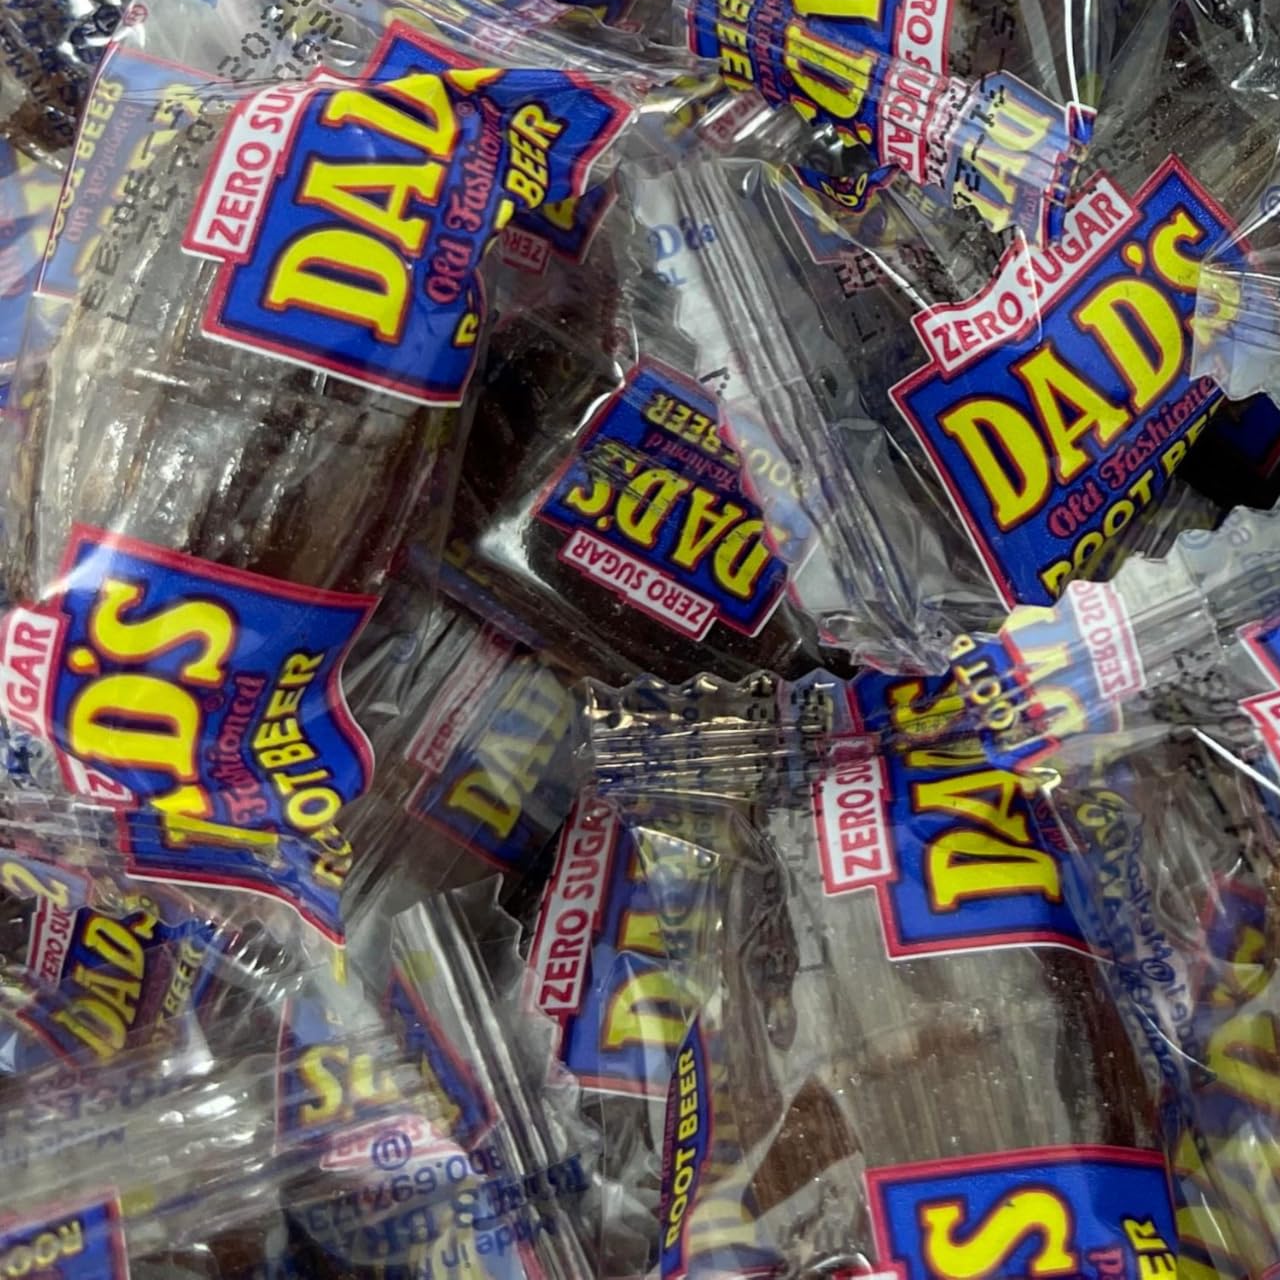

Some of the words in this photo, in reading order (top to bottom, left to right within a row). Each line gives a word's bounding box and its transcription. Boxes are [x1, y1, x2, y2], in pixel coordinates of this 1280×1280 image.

[506, 104, 564, 206] BEER
[880, 50, 938, 172] SUGAR
[209, 140, 267, 248] ZERO
[430, 240, 473, 304] Old
[932, 288, 1024, 362] ZERO
[1017, 196, 1126, 306] SUGAR
[942, 212, 1240, 531] DAD'S
[570, 465, 772, 600] DAD'S
[572, 537, 648, 586] SUGAR
[1048, 483, 1101, 538] Old
[643, 572, 704, 624] ZERO
[252, 652, 325, 760] BEER
[838, 788, 880, 878] ZERO
[541, 910, 588, 1010] ZERO
[677, 1047, 696, 1136] BEER
[665, 1145, 700, 1249] ROOT
